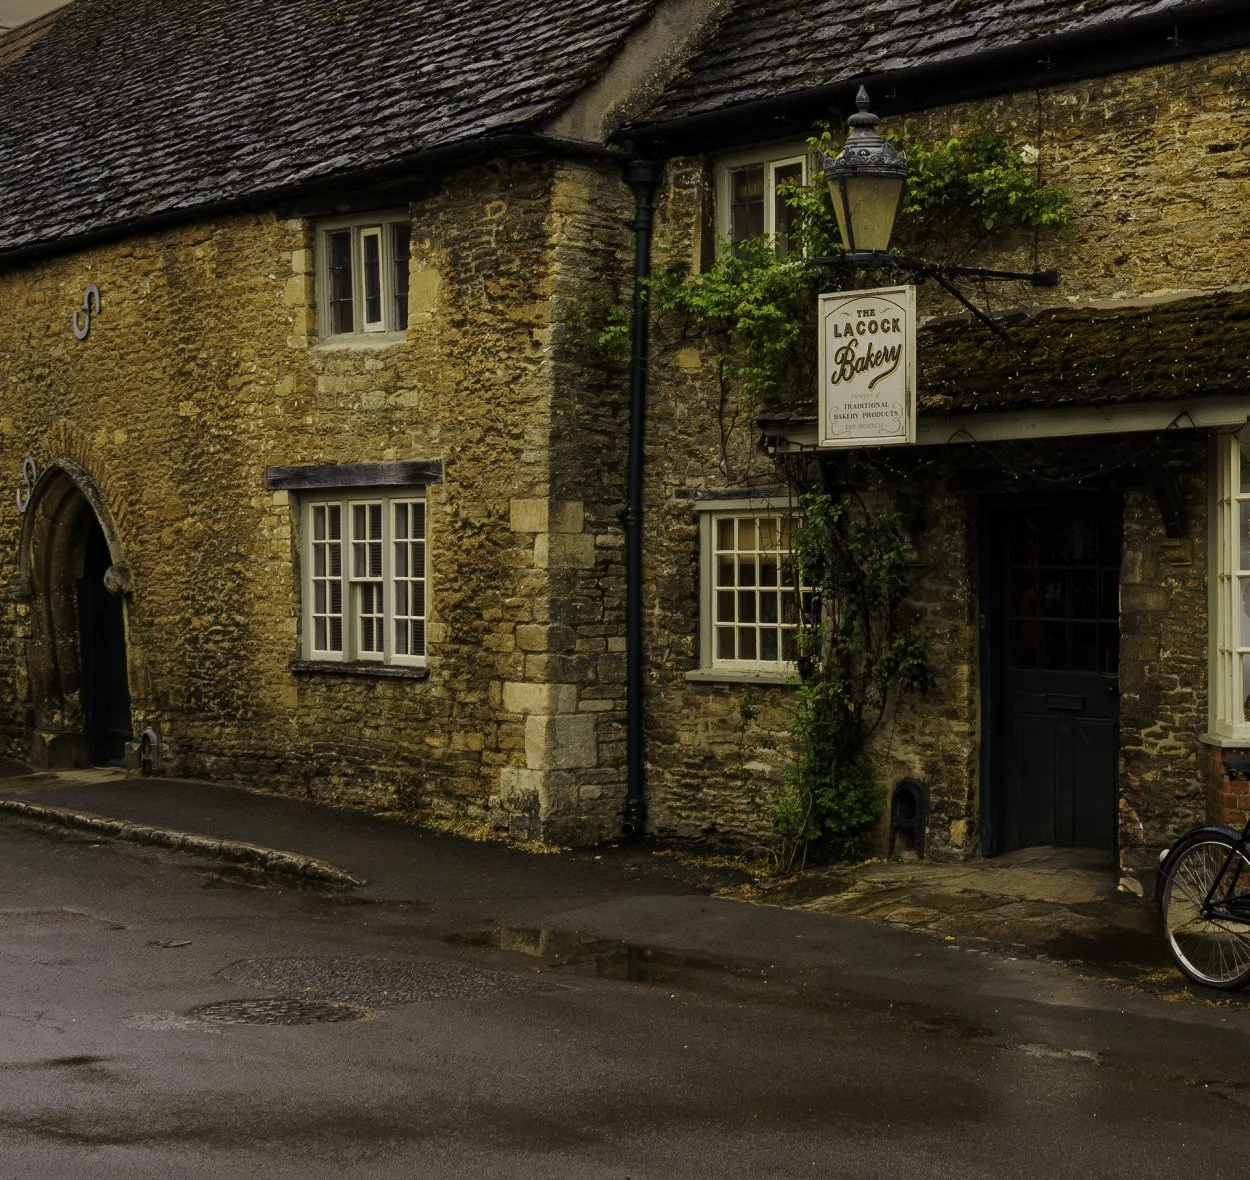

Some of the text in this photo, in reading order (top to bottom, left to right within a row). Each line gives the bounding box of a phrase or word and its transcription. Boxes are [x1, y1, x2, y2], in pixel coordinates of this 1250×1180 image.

[856, 308, 876, 318] THE
[833, 317, 902, 338] LACOCK
[831, 337, 903, 390] Bakery
[843, 401, 889, 410] TRADITIONAL
[833, 410, 899, 420] BAKERY PRODUCTS
